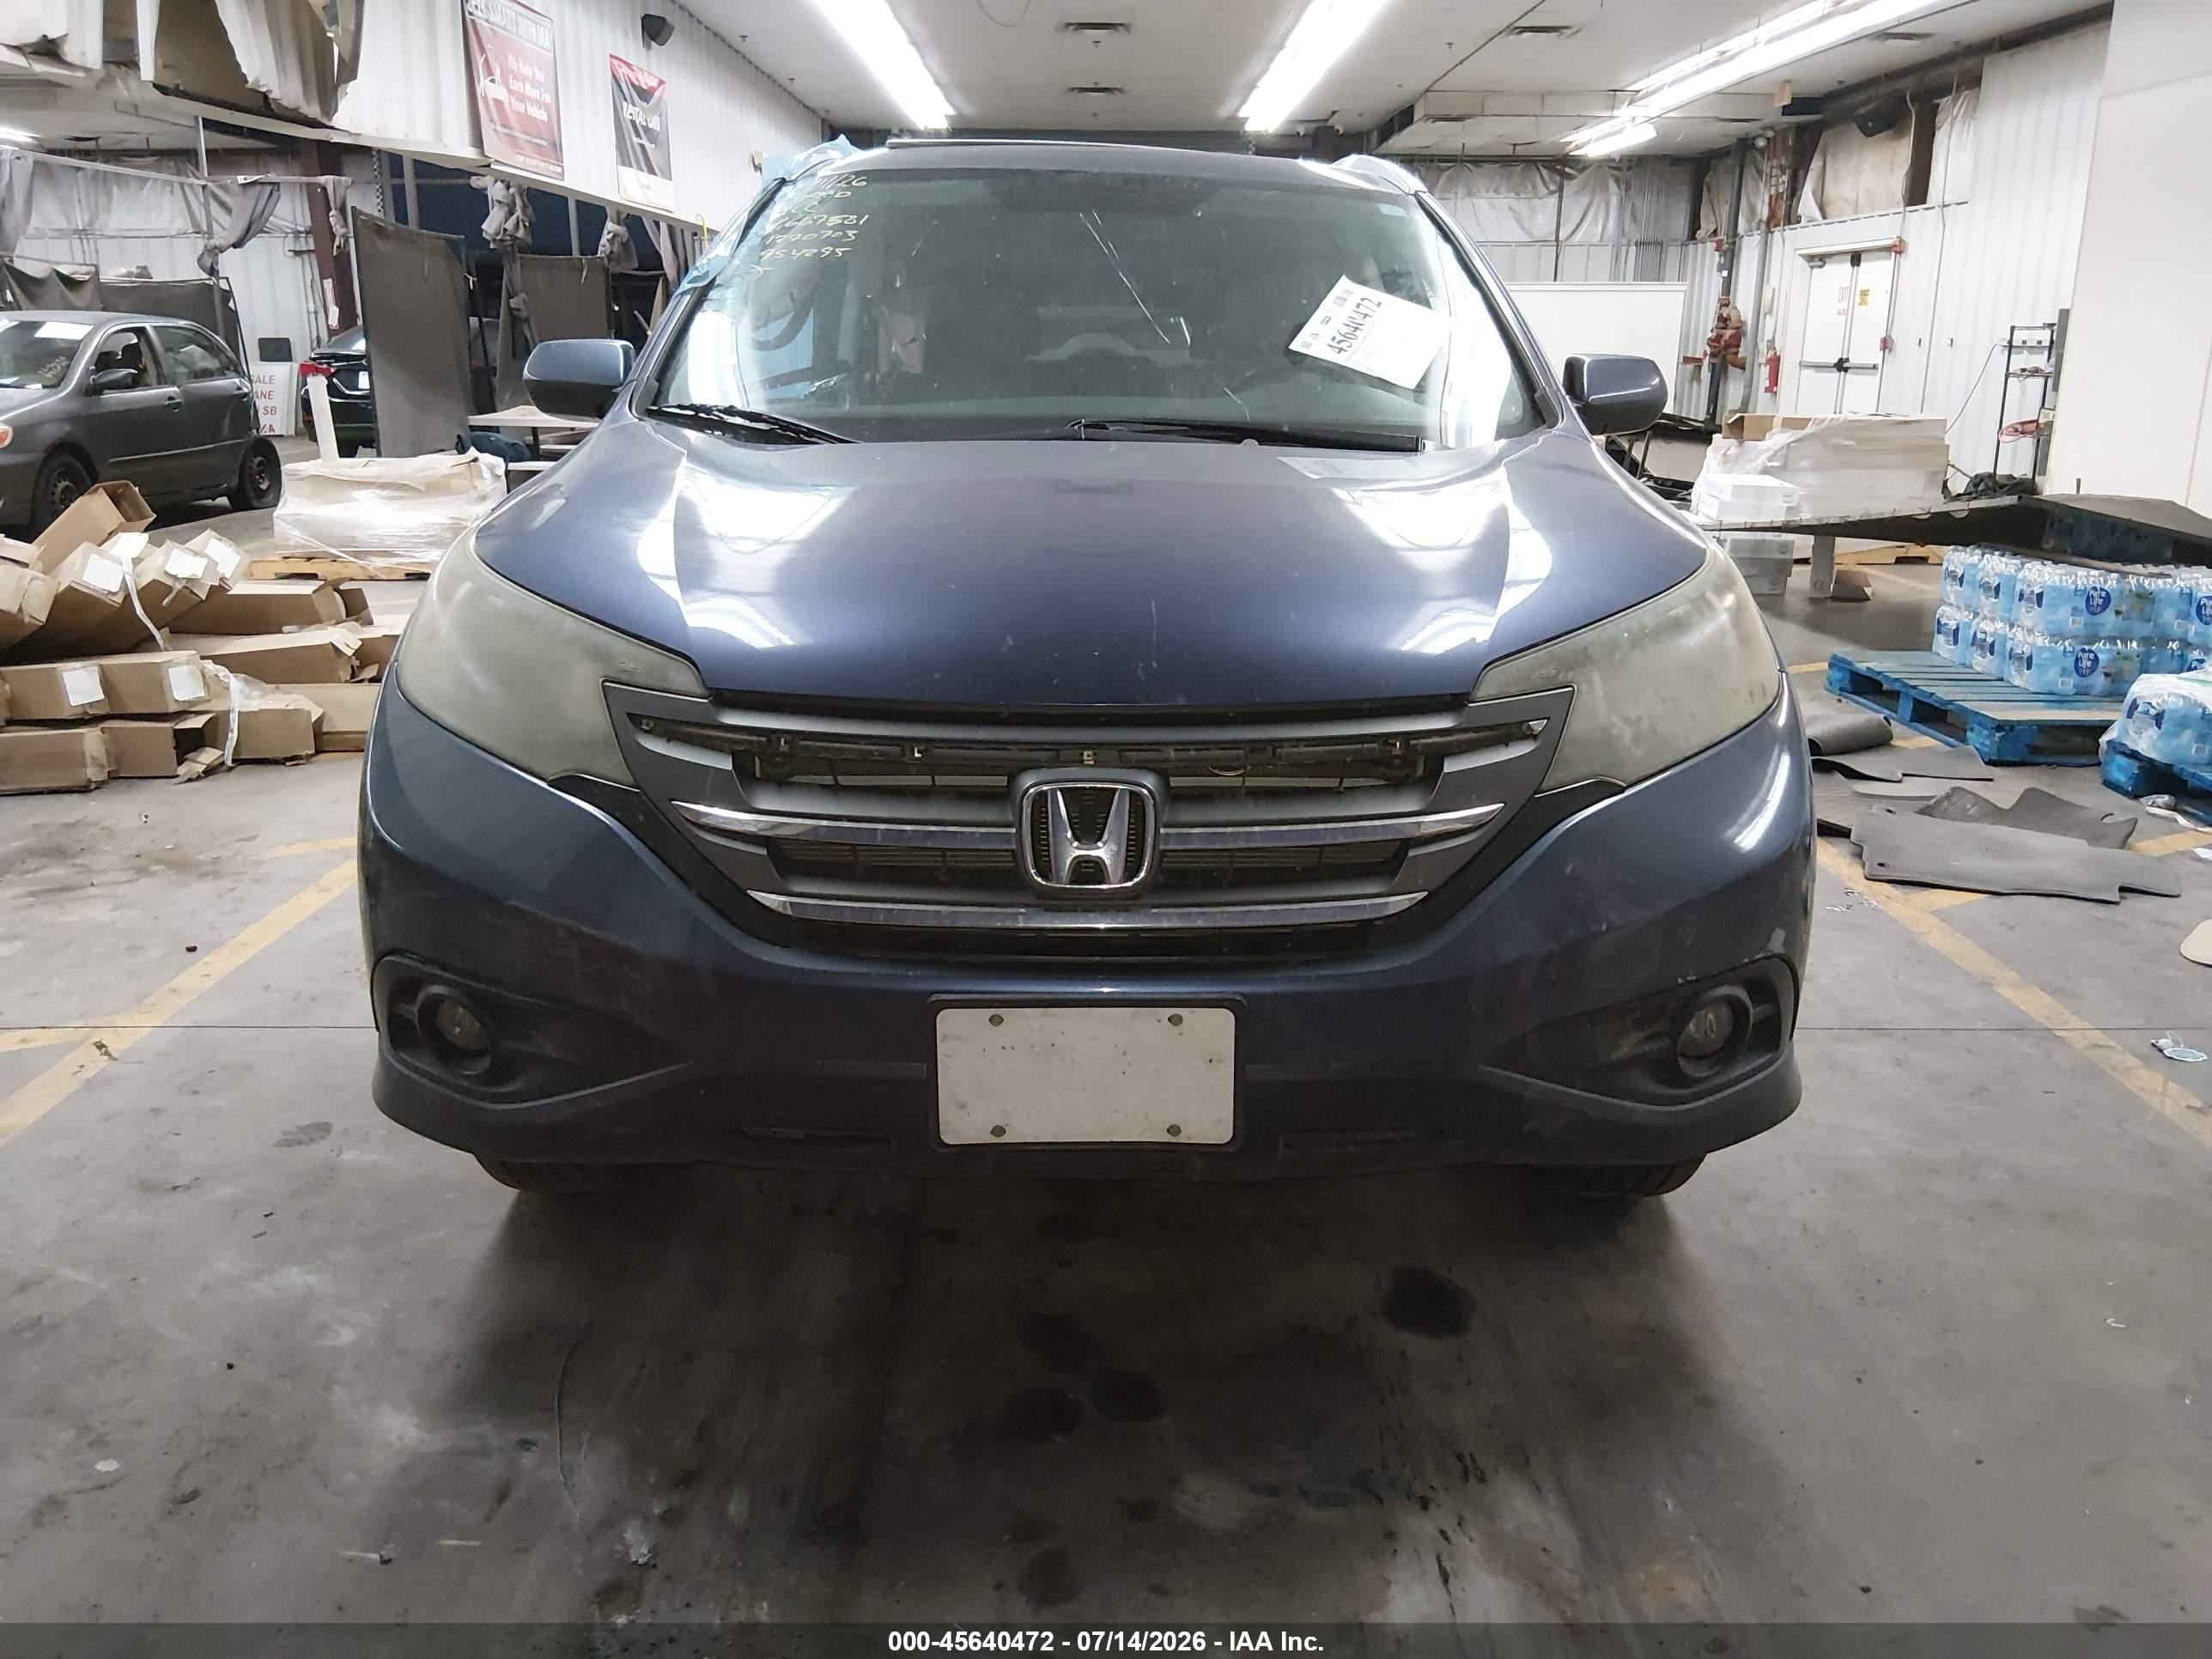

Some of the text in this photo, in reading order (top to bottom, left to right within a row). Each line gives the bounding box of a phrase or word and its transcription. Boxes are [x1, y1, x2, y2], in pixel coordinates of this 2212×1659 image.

[2088, 589, 2106, 599] Pure
[2089, 597, 2104, 605] Life
[2077, 651, 2095, 660] Pure
[2078, 658, 2093, 668] Life
